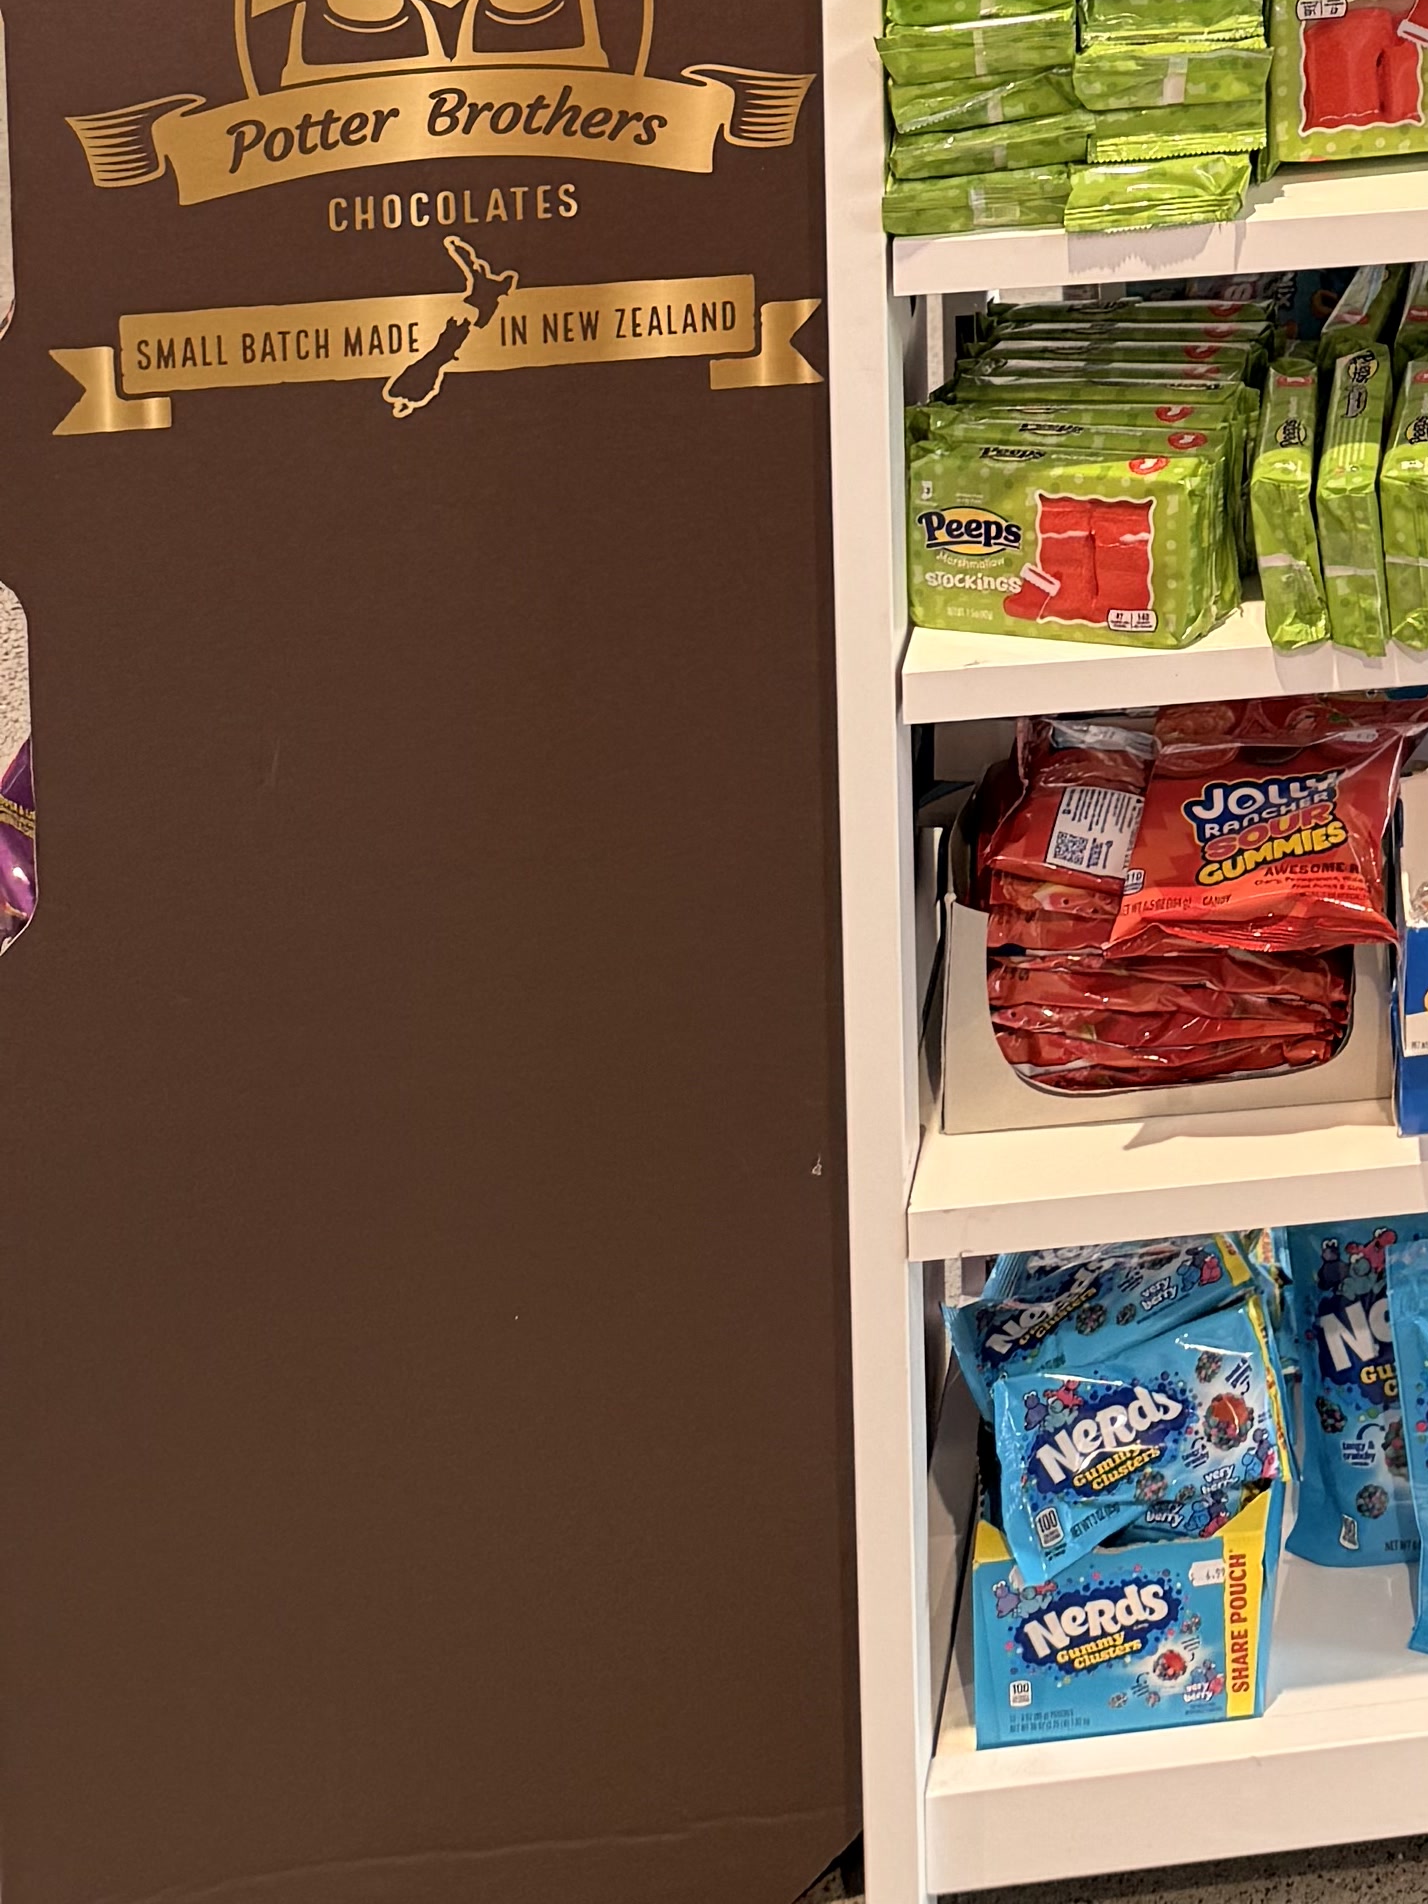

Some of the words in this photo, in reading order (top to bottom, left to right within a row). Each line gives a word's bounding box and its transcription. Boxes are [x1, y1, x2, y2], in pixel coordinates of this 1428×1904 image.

[226, 104, 400, 174] Potter
[428, 86, 668, 148] Brothers
[328, 183, 580, 234] CHOCOLATES
[136, 334, 230, 372] SMALL
[240, 329, 332, 366] BATCH
[343, 322, 421, 358] MADE
[500, 316, 529, 349] IN
[541, 311, 601, 345] NEW
[615, 299, 738, 341] ZEALAND
[917, 510, 1023, 551] Peeps
[1192, 772, 1340, 819] JOLLY
[1205, 791, 1330, 838] RANCHER
[1199, 821, 1347, 886] GUMMIES
[1205, 804, 1333, 860] SOUR
[1263, 862, 1345, 876] AWESOME
[1073, 1440, 1141, 1487] Gummy
[1092, 1446, 1161, 1491] Clusters
[1037, 1514, 1058, 1531] 100
[1230, 1552, 1247, 1622] POUCH
[1056, 1633, 1126, 1664] Gummy
[1073, 1639, 1142, 1670] Clusters
[1231, 1628, 1250, 1694] SHARE
